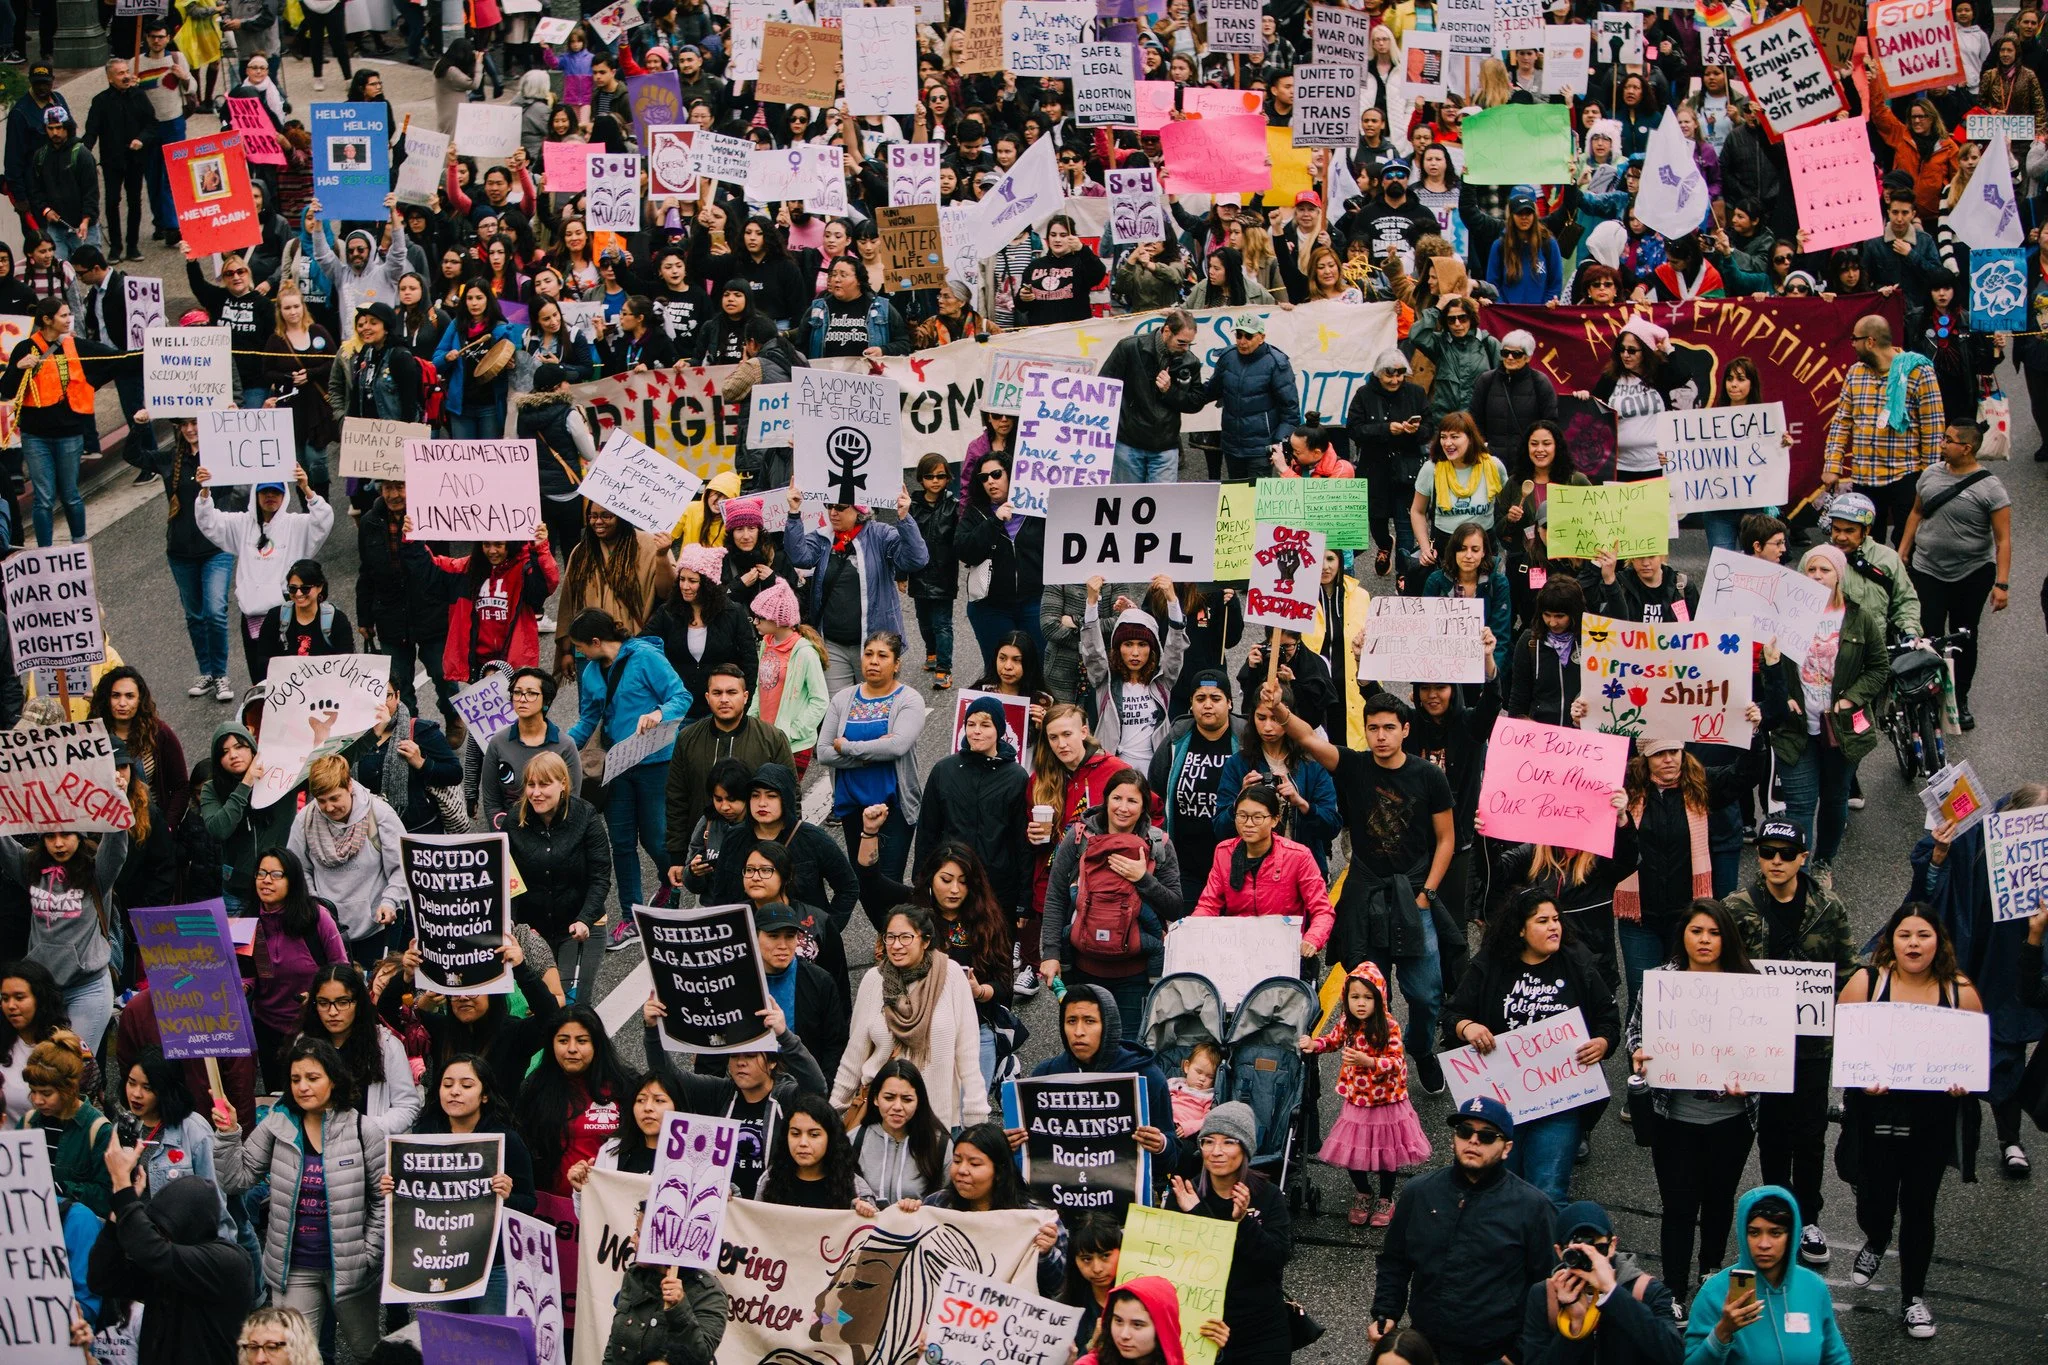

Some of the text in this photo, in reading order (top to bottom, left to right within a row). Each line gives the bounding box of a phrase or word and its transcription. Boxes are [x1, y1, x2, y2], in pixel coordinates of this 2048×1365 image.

[1447, 0, 1485, 10] LEGAL
[1880, 0, 1945, 27] STOP
[846, 15, 911, 41] Sisters
[1215, 18, 1256, 30] TRANS
[1316, 11, 1367, 30] END THE
[1440, 22, 1491, 33] ABORTION
[860, 40, 890, 55] NOT
[1216, 33, 1255, 44] LIVES!
[1317, 28, 1365, 46] WAR ON
[1455, 35, 1490, 45] DEMAND
[1875, 24, 1951, 59] BANNON
[860, 55, 896, 73] Just
[1082, 63, 1123, 76] LEGAL
[1898, 47, 1952, 77] NOW!
[1300, 68, 1354, 80] UNITE TO
[1077, 88, 1132, 100] ABORTION
[1299, 85, 1356, 99] DEFEND
[1759, 71, 1821, 107] WILL NOT
[236, 115, 265, 129] TOOK
[1301, 106, 1351, 120] TRANS
[1968, 116, 2035, 129] STRONGER
[1302, 122, 1349, 136] LIVES!
[317, 176, 340, 186] HAS
[882, 230, 938, 250] WATER
[892, 256, 925, 268] LIFE
[217, 319, 257, 332] MATTER
[161, 354, 212, 367] WOMEN
[149, 369, 199, 381] SELDOM
[188, 382, 227, 395] MAKE
[800, 376, 885, 397] A WOMAN'S
[152, 395, 214, 407] HISTORY
[758, 392, 790, 412] not
[803, 388, 882, 411] PLACE IS IN
[211, 410, 278, 434] DEPORT
[797, 402, 892, 426] THE STRUGGLE
[1036, 400, 1111, 431] believe
[370, 421, 398, 434] NO
[1020, 420, 1115, 449] I STILL
[1672, 411, 1776, 442] ILLEGAL
[344, 430, 390, 447] HUMAN
[412, 443, 530, 463] UNDOCUMENTED
[1019, 441, 1097, 465] have to
[1664, 441, 1768, 475] BROWN &
[1014, 459, 1111, 486] PROTEST
[439, 471, 485, 498] AND
[620, 465, 684, 505] FREEDOM!
[1555, 484, 1649, 506] I AM NOT
[1684, 473, 1757, 501] NASTY
[1094, 496, 1157, 526] NO
[1256, 499, 1302, 517] AMERICA
[1273, 526, 1313, 548] OUR
[1575, 536, 1658, 554] ACCOMPLICE
[1062, 532, 1194, 565] DAPL
[6, 552, 87, 584] END THE
[10, 580, 88, 608] WAR ON
[1273, 578, 1295, 595] IS
[1247, 588, 1317, 621] RESISTANCE
[1785, 582, 1824, 614] VOICES
[12, 607, 94, 634] WOMEN'S
[18, 630, 95, 657] RIGHTS!
[264, 656, 389, 713] Together United
[1123, 702, 1149, 711] PUTAS
[1660, 680, 1729, 713] shit!
[1122, 711, 1141, 719] SOLO
[1540, 731, 1604, 762] BODIES
[1181, 764, 1208, 780] FUL
[1177, 777, 1196, 792] IN
[0, 771, 135, 830] IVIL RIGHTS
[1176, 790, 1218, 806] EVER
[1531, 793, 1591, 824] POWER
[412, 849, 489, 868] ESCUDO
[411, 870, 493, 891] CONTRA
[30, 885, 85, 901] WONDER
[31, 898, 83, 912] WOMAN
[418, 893, 493, 916] Detención y
[418, 912, 492, 939] Deportación
[652, 924, 733, 944] SHIELD
[421, 941, 495, 970] Inmigrantes
[446, 941, 456, 950] de
[651, 943, 747, 969] AGAINST
[1764, 965, 1833, 978] A Womxn
[672, 973, 736, 994] Racism
[1802, 981, 1834, 995] from
[703, 996, 712, 1007] &
[681, 1006, 743, 1027] Sexism
[1796, 1001, 1826, 1026] n!
[1505, 1022, 1578, 1068] Perdon
[1652, 1035, 1680, 1060] Soy
[1711, 1043, 1736, 1064] que
[1887, 1072, 1914, 1086] your
[1888, 1062, 1918, 1076] your
[1037, 1091, 1120, 1110] SHIELD
[1030, 1116, 1132, 1138] AGAINST
[403, 1152, 484, 1172] SHIELD
[1052, 1144, 1115, 1168] Racism
[1079, 1171, 1087, 1183] &
[395, 1178, 494, 1200] AGAINST
[1052, 1184, 1113, 1207] Sexism
[0, 1187, 52, 1236] ITY
[414, 1207, 475, 1231] Racism
[439, 1235, 448, 1246] &
[1135, 1208, 1230, 1252] THERE
[6, 1245, 71, 1280] FEAR
[412, 1247, 470, 1270] Sexism
[980, 1286, 1020, 1310] ABOUT
[1022, 1302, 1048, 1321] TIME
[1050, 1314, 1072, 1327] WE
